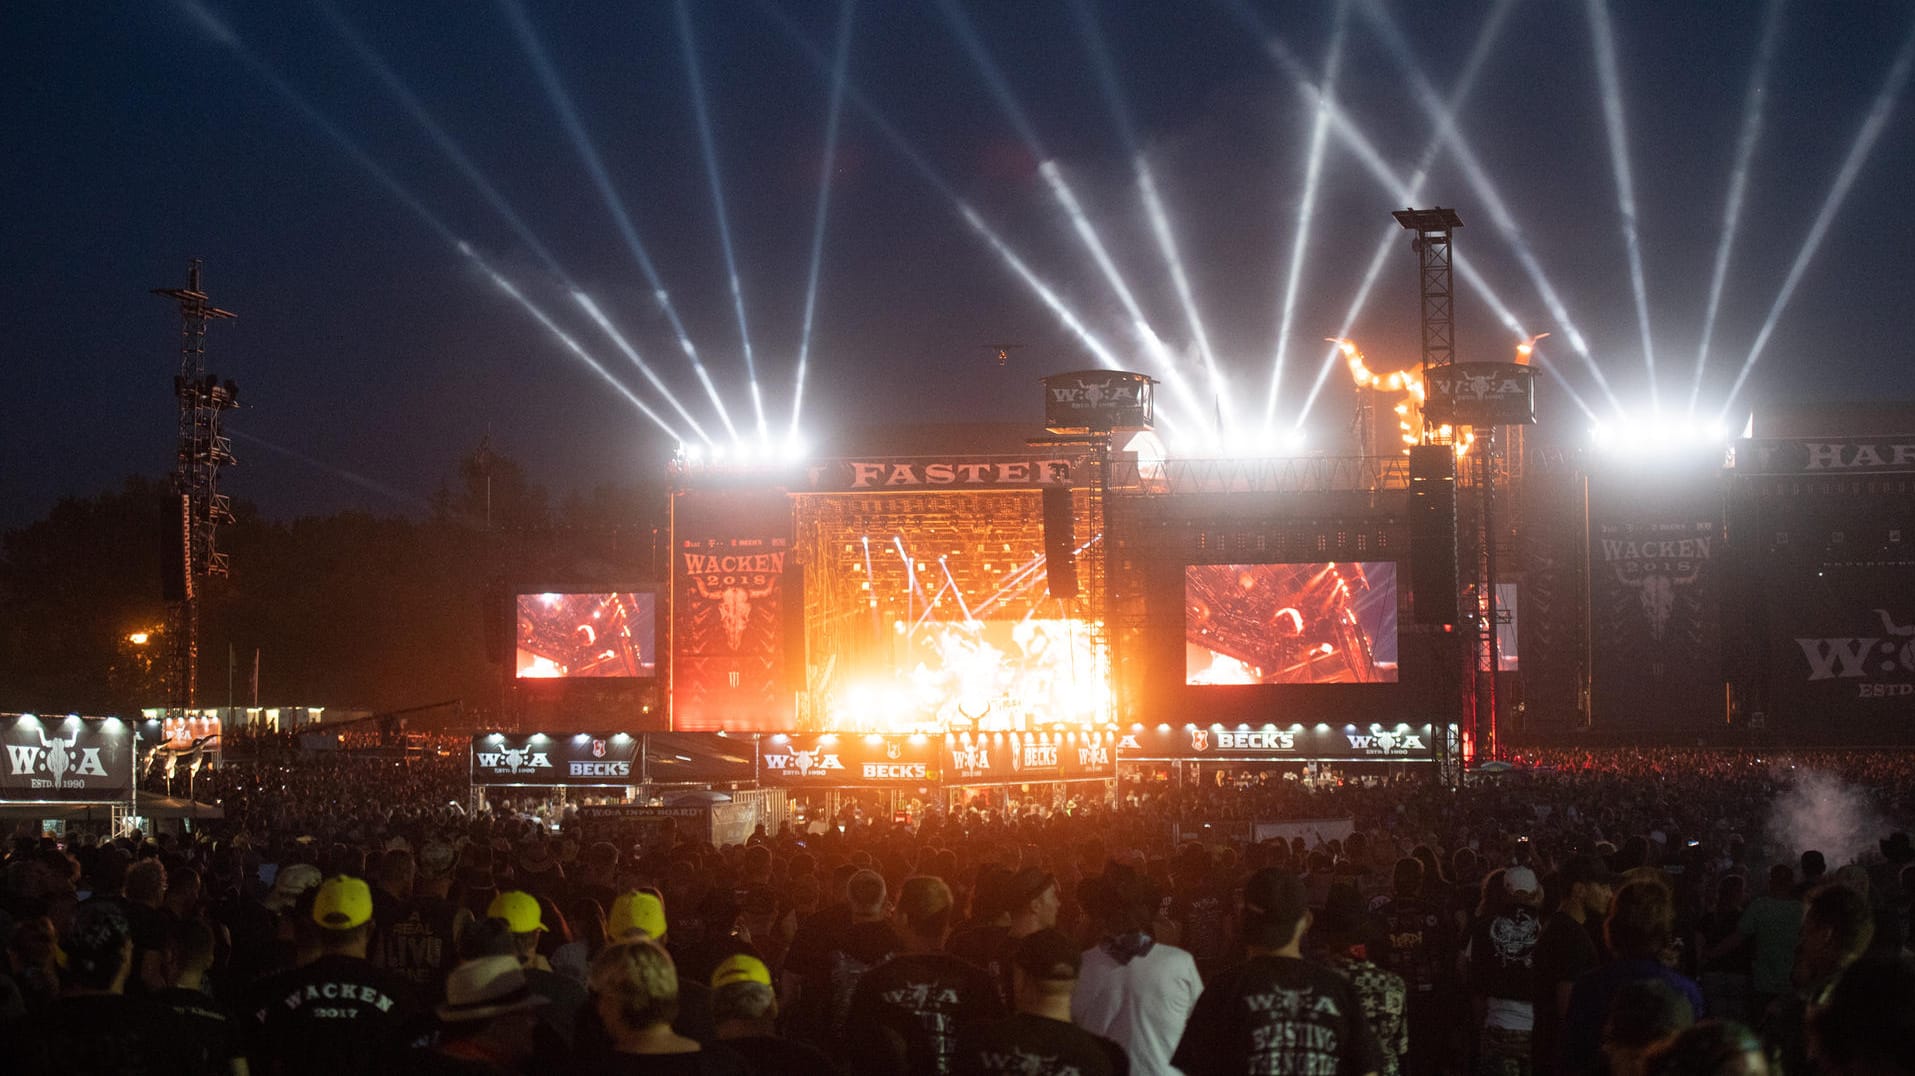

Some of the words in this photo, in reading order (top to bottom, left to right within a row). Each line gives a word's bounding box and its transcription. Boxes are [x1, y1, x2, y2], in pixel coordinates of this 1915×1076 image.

[851, 459, 1073, 488] FASTER
[1602, 537, 1712, 560] WACKEN
[684, 552, 785, 575] WACKEN
[707, 575, 766, 586] 2018
[1218, 732, 1294, 748] BECK'S
[570, 762, 630, 776] BECK'S
[863, 764, 926, 778] BECK'S
[63, 780, 85, 789] 1990
[657, 808, 697, 816] BOARD
[284, 982, 394, 1013] WACKEN
[314, 1007, 359, 1019] 2017
